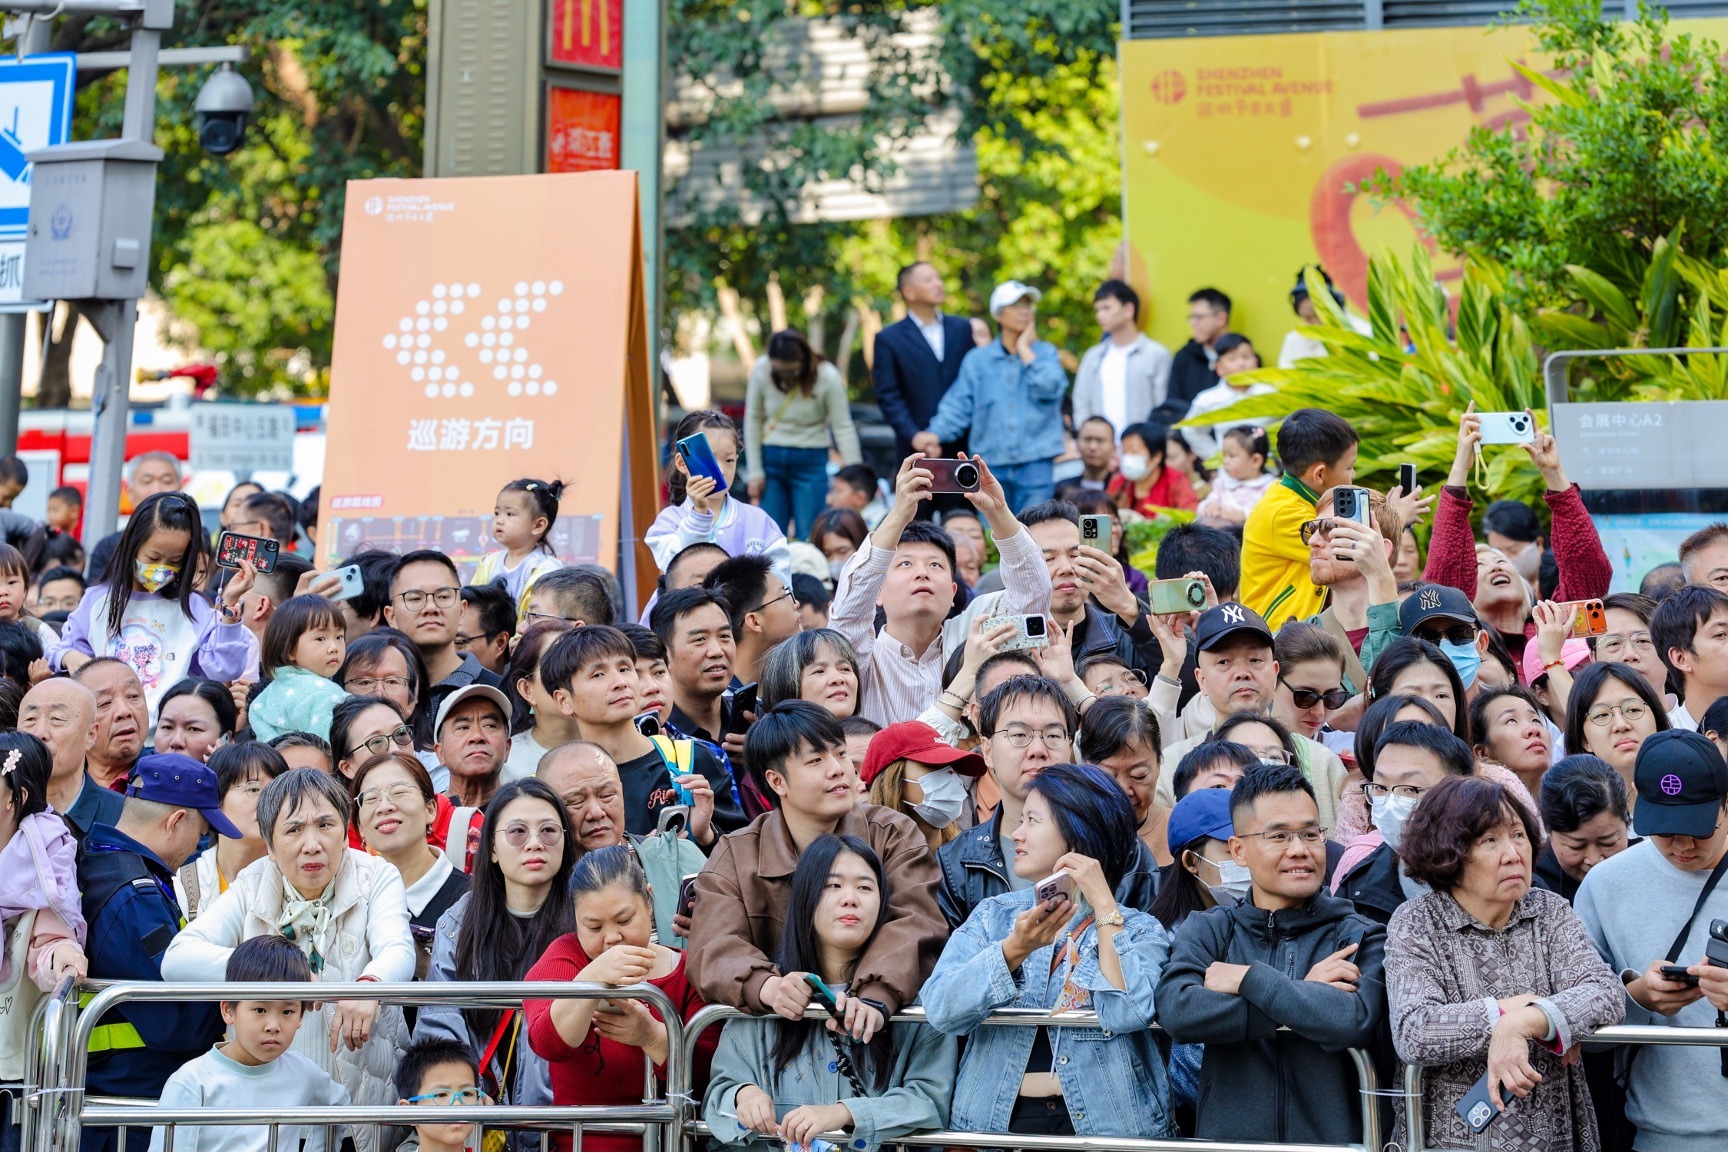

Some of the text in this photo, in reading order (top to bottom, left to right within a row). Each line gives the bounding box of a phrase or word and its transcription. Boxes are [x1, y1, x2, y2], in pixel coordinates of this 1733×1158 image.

[1196, 67, 1283, 80] SHENZHEN
[1196, 80, 1333, 96] FESTIVAL AVENUE
[387, 195, 431, 203] SHENZHEN
[387, 202, 455, 211] FESTIVAL AVENUE
[1579, 413, 1663, 428] 会展中心A2
[406, 416, 535, 451] 巡游方向
[1420, 589, 1442, 610] NY
[1221, 605, 1246, 624] NY
